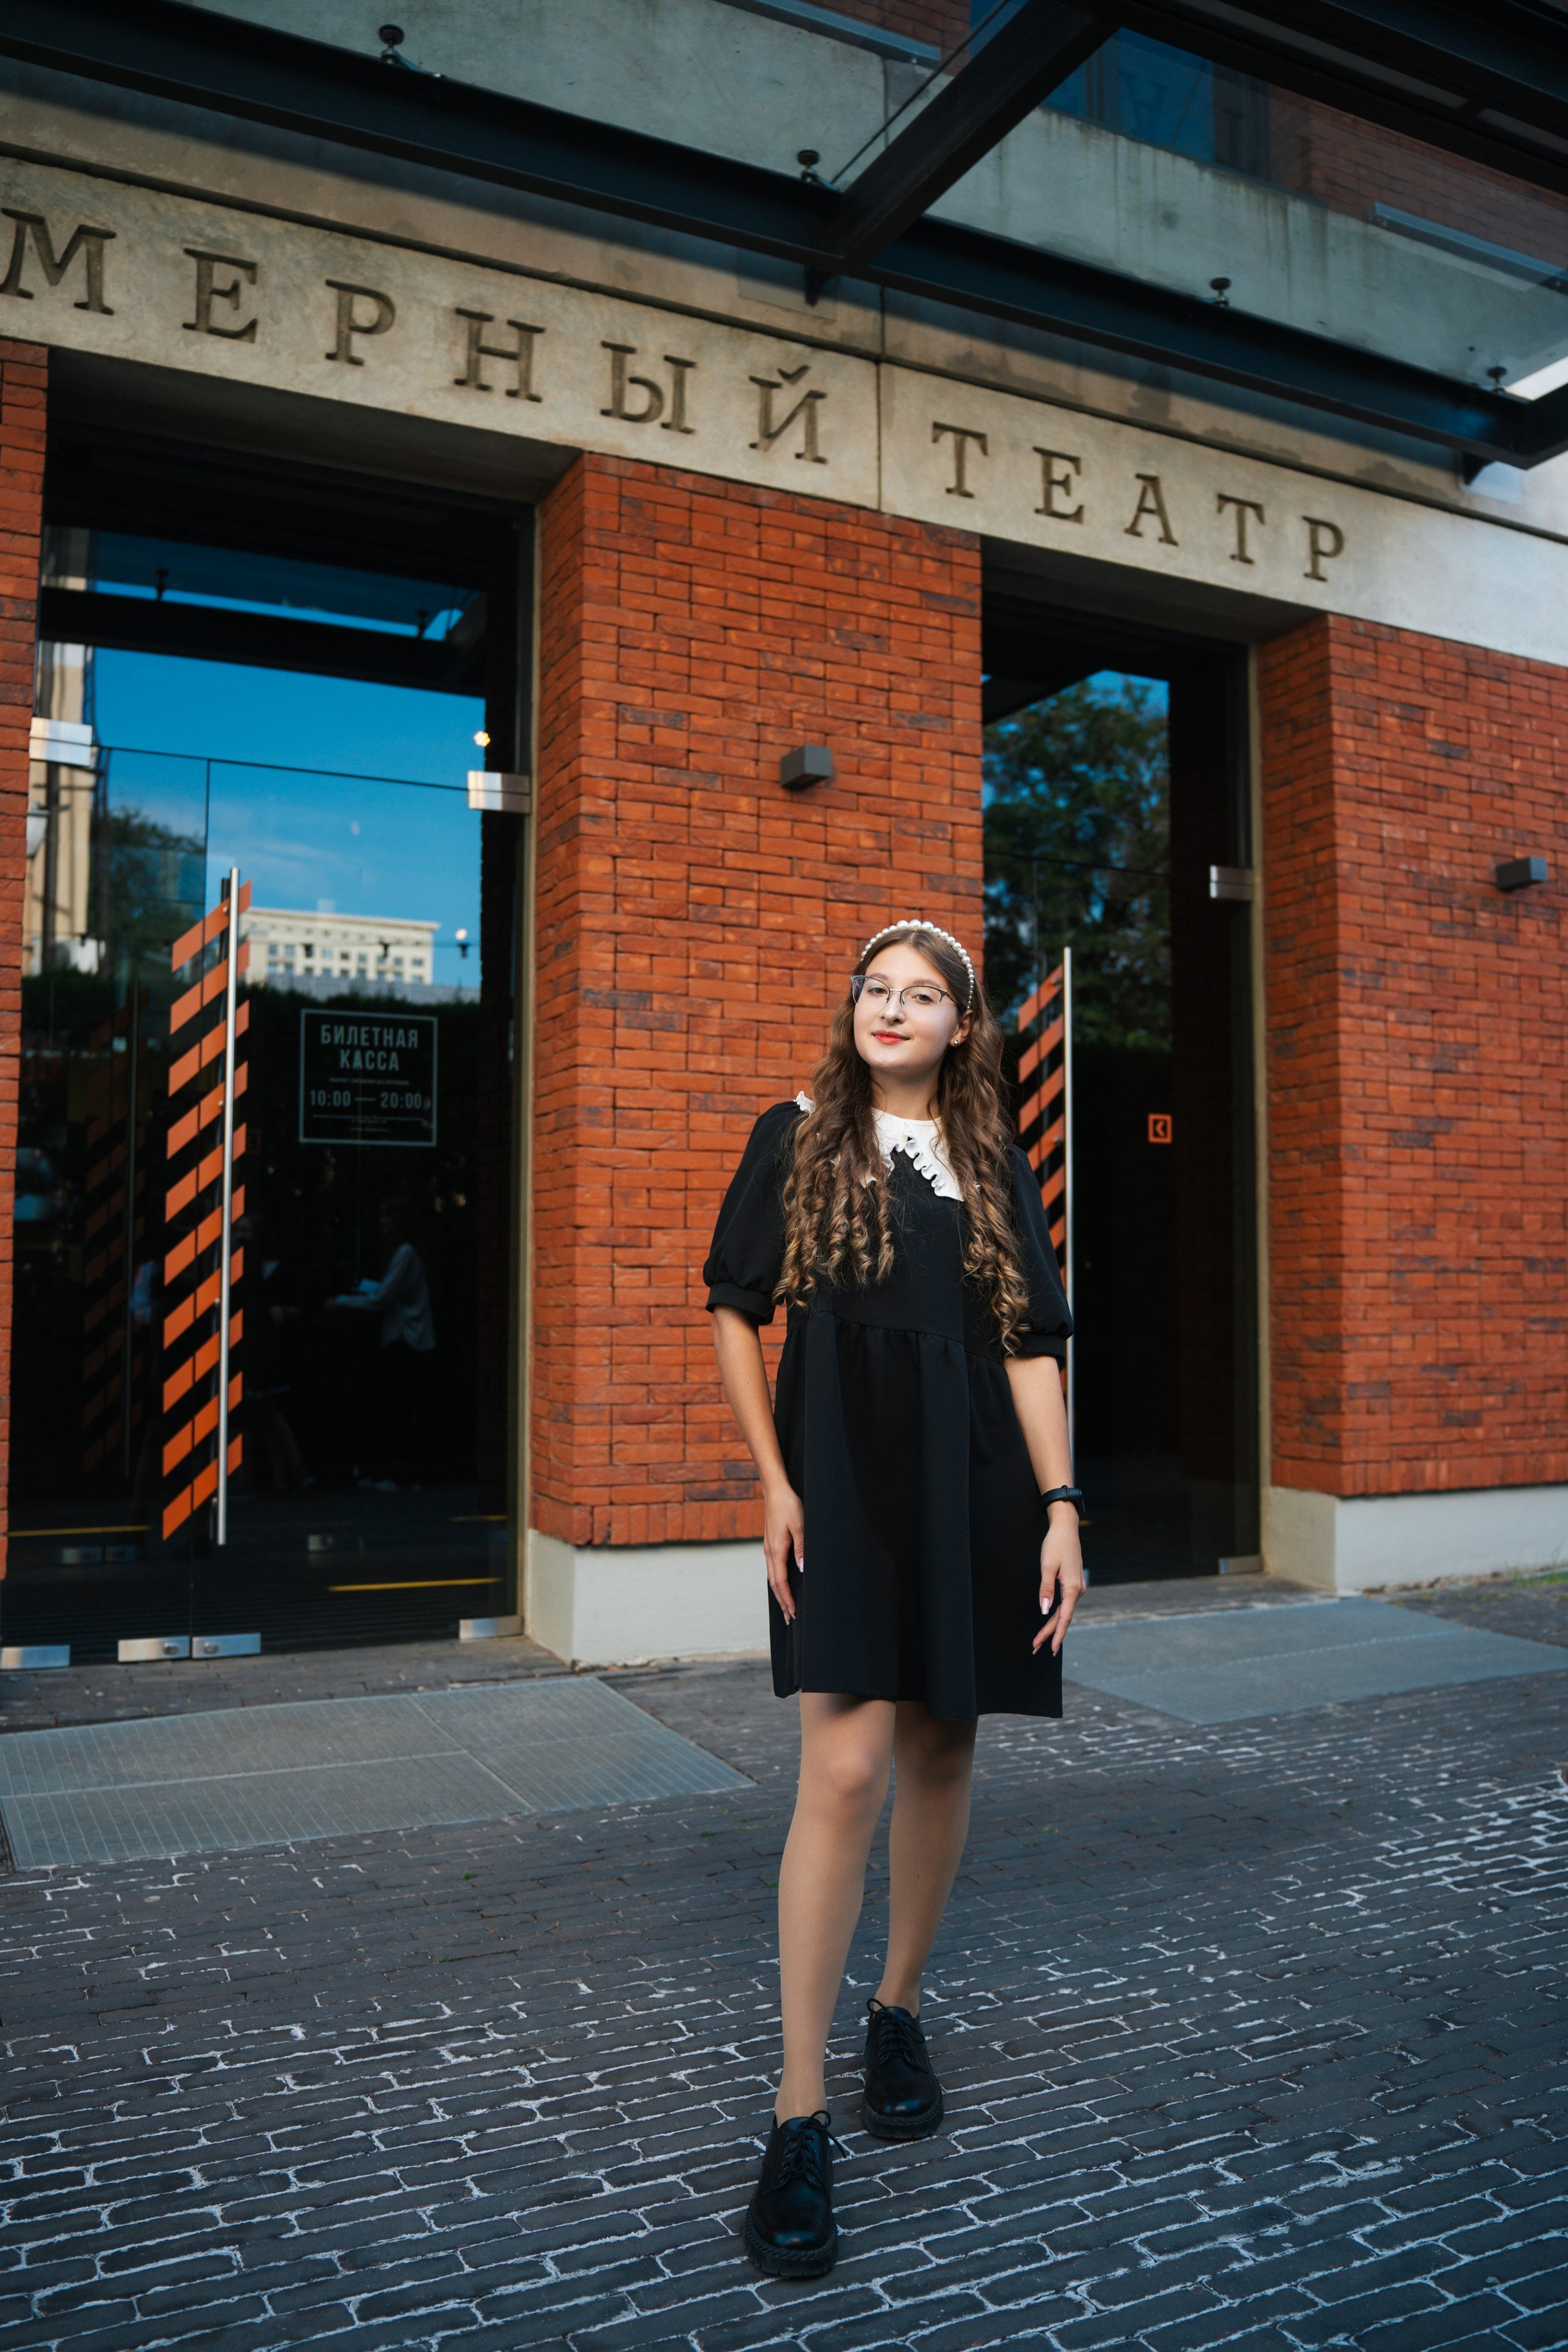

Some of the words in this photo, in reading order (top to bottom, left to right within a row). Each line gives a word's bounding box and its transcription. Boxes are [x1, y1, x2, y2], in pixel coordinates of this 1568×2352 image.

[0, 207, 827, 464] МЕРНЫЙ
[932, 421, 1344, 582] ТЕАТР
[320, 1023, 418, 1049] БИЛЕТНАЯ
[339, 1049, 399, 1071] КАССА
[310, 1090, 351, 1107] 10:00
[380, 1091, 422, 1109] 20:00
